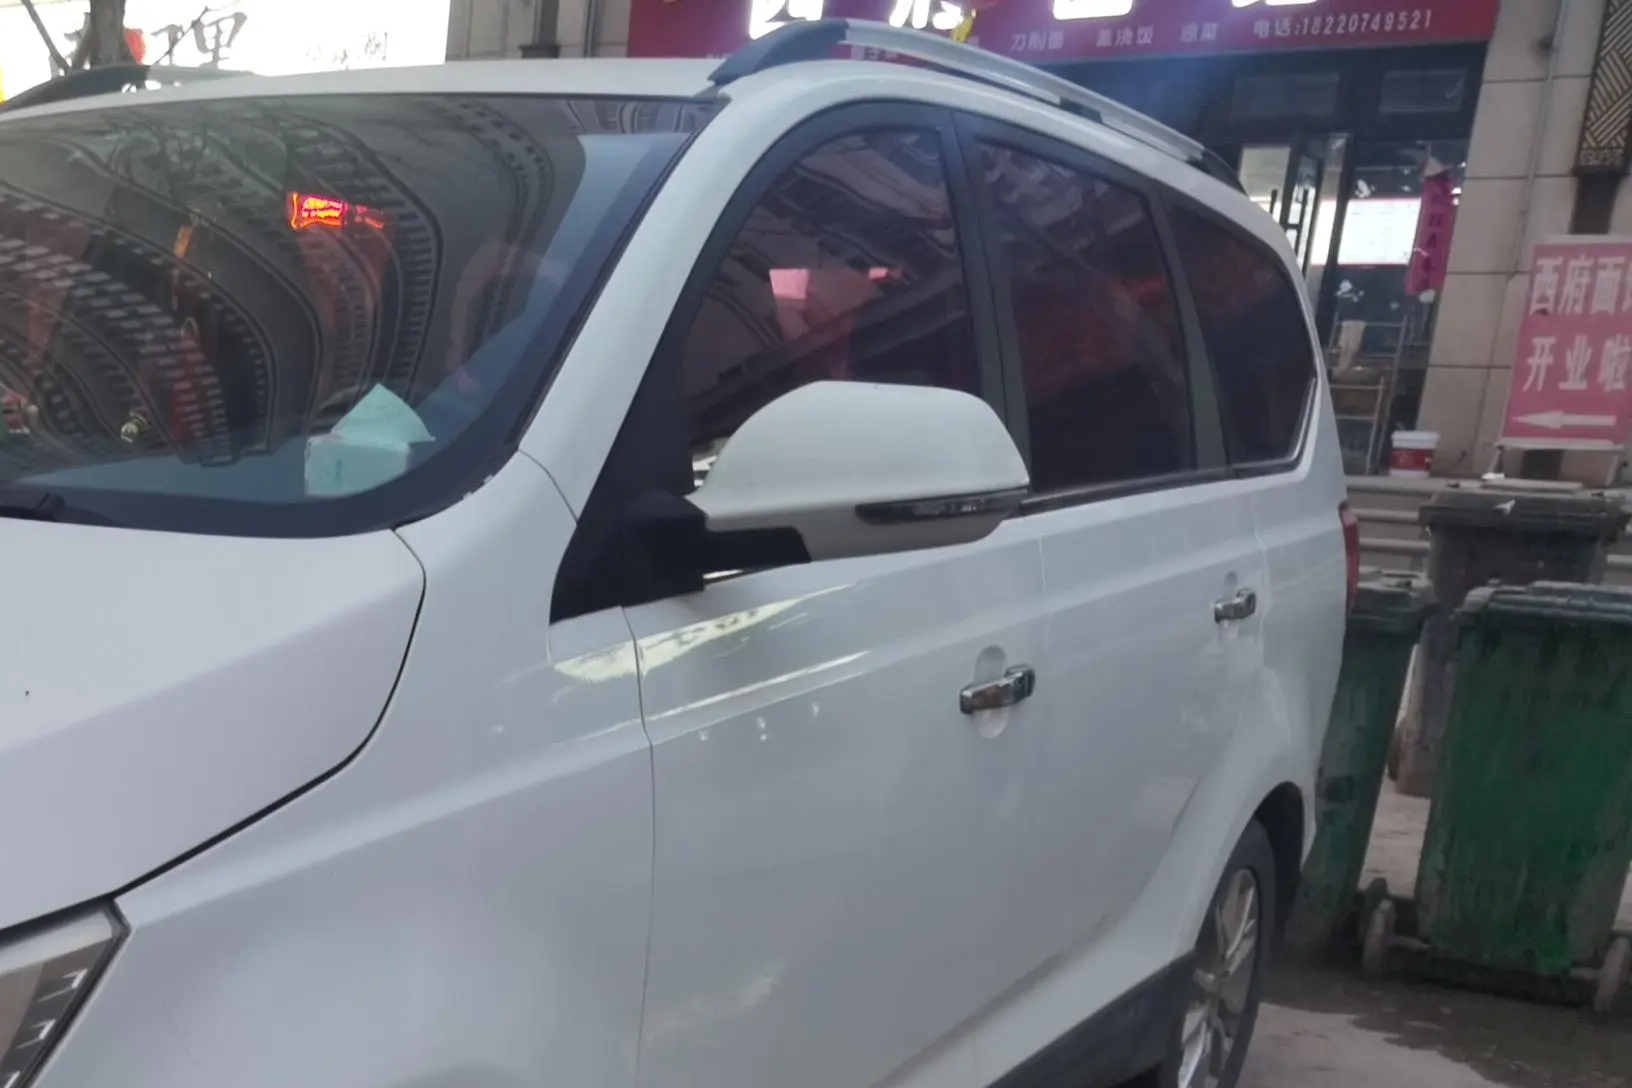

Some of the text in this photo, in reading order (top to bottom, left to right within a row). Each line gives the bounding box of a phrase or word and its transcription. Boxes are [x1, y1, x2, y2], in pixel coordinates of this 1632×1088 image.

[1529, 255, 1632, 316] 西府面
[1522, 333, 1630, 392] 开业啦
